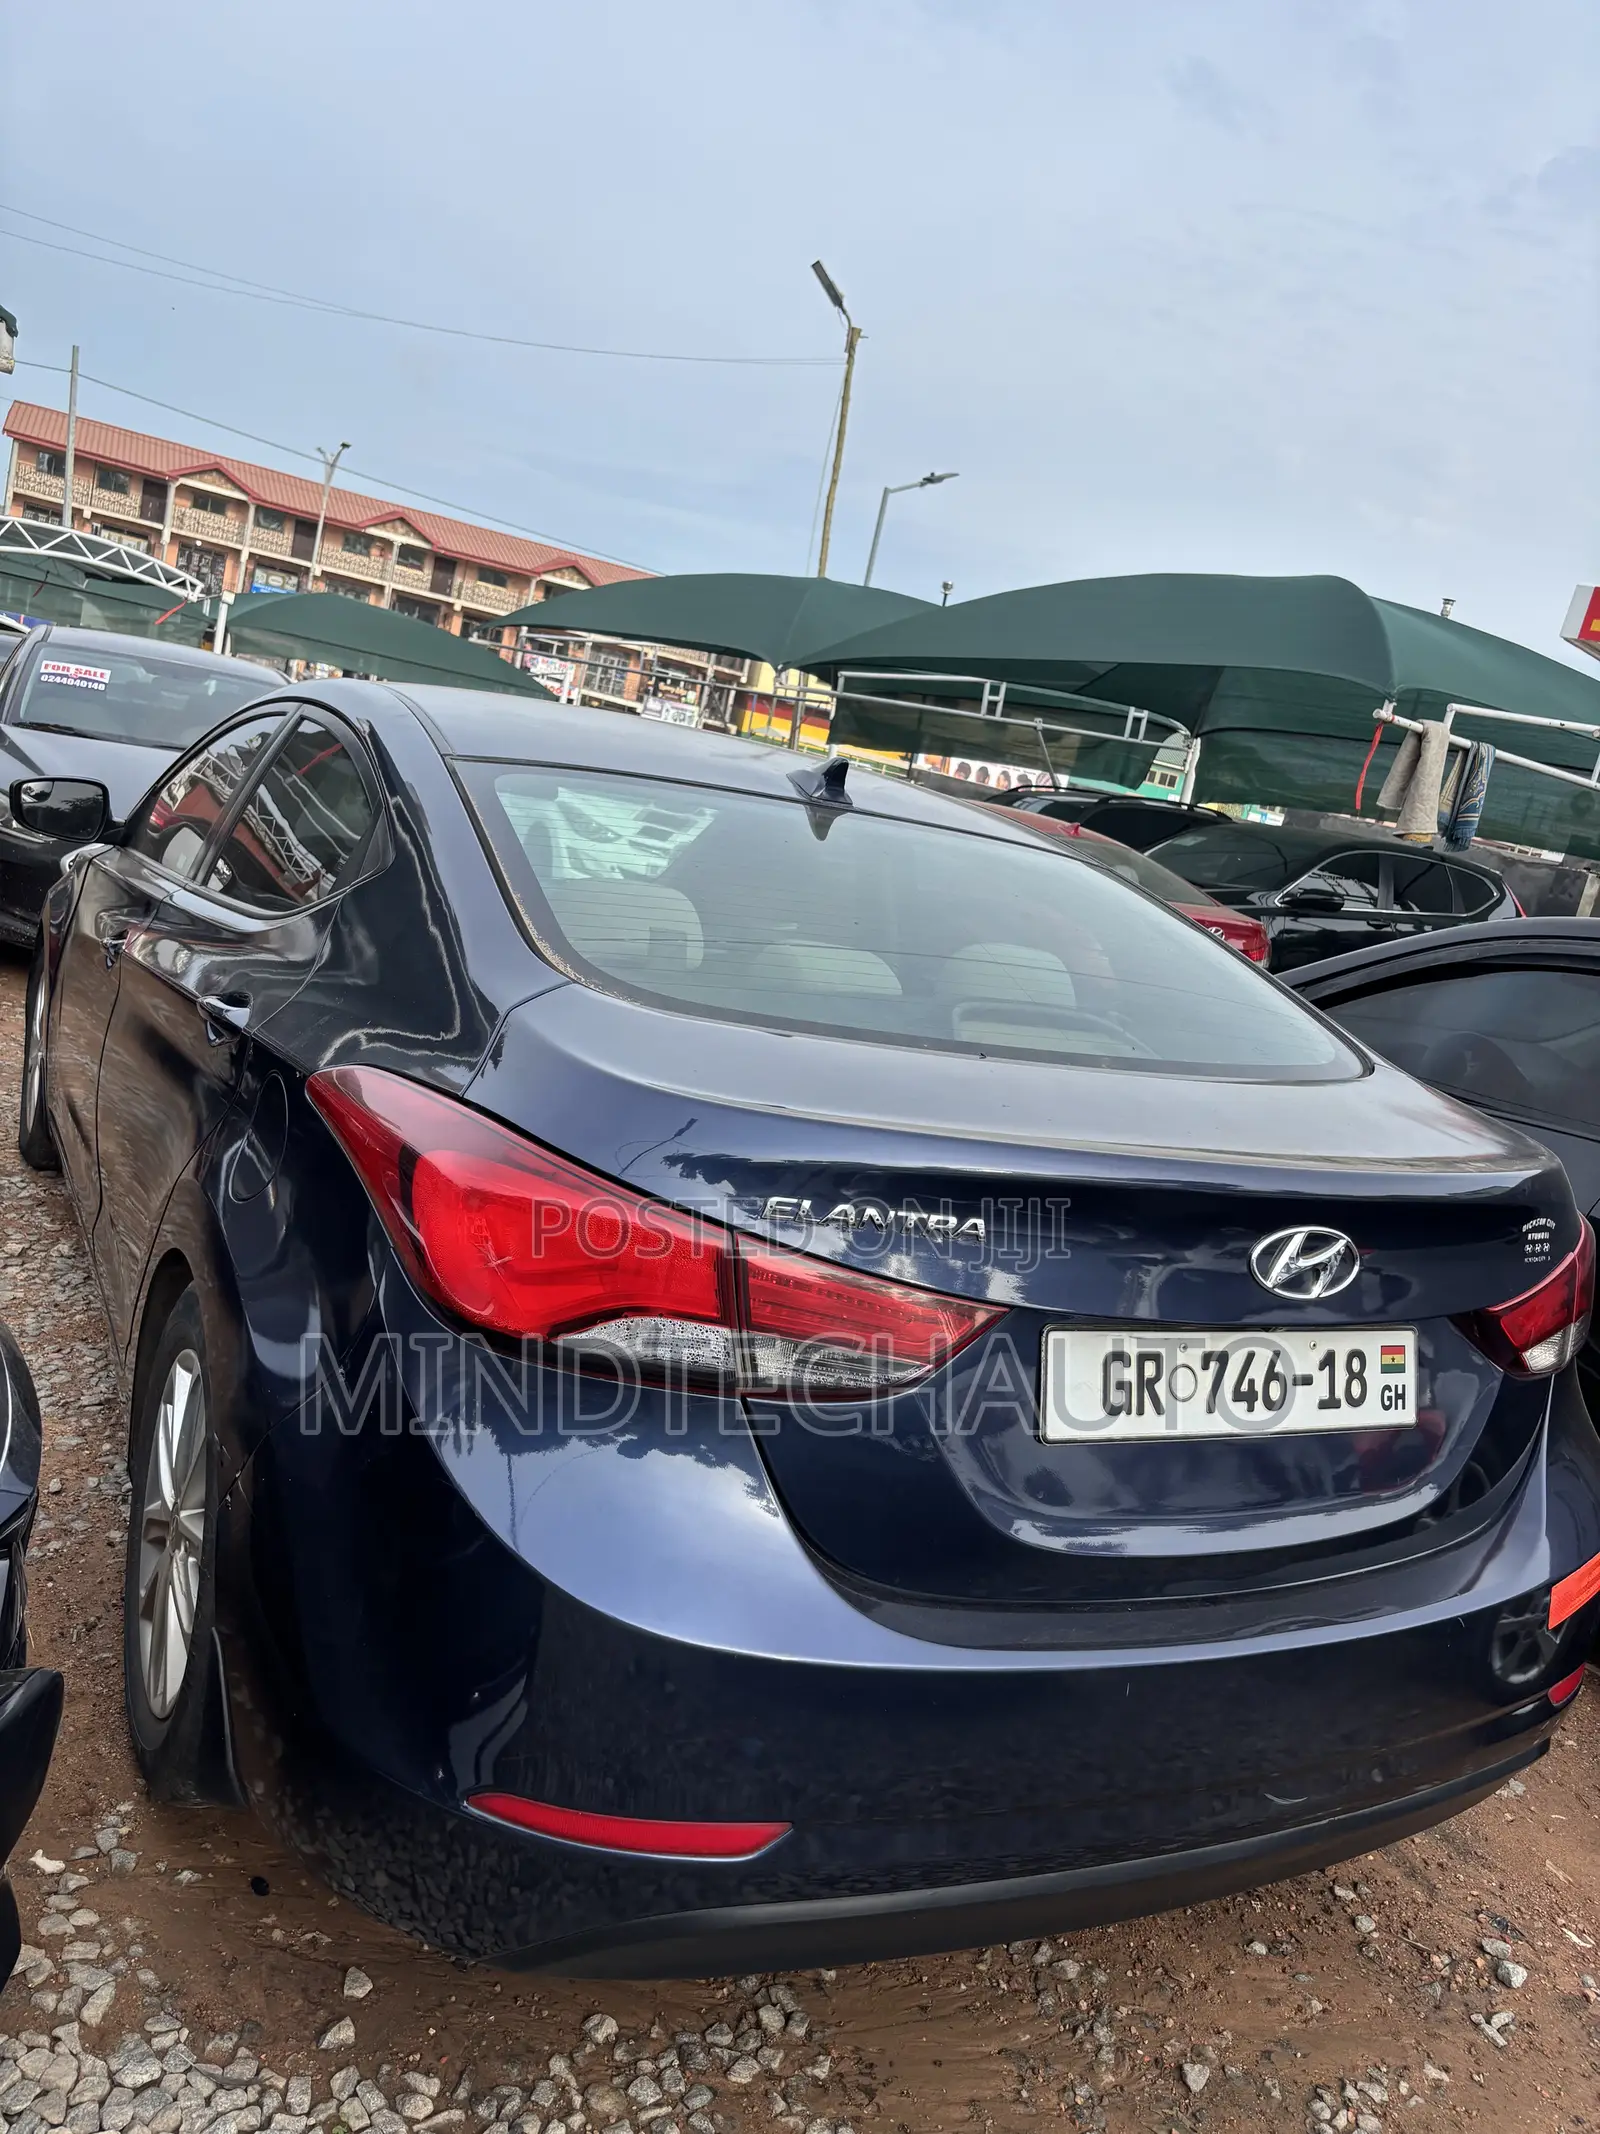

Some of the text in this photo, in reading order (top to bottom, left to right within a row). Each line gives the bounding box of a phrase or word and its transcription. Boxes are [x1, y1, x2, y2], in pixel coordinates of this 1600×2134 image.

[44, 663, 106, 679] FOR SALE
[760, 1196, 987, 1242] ELANTRA
[1102, 1348, 1368, 1416] GR 746-18
[1380, 1384, 1406, 1412] GH
